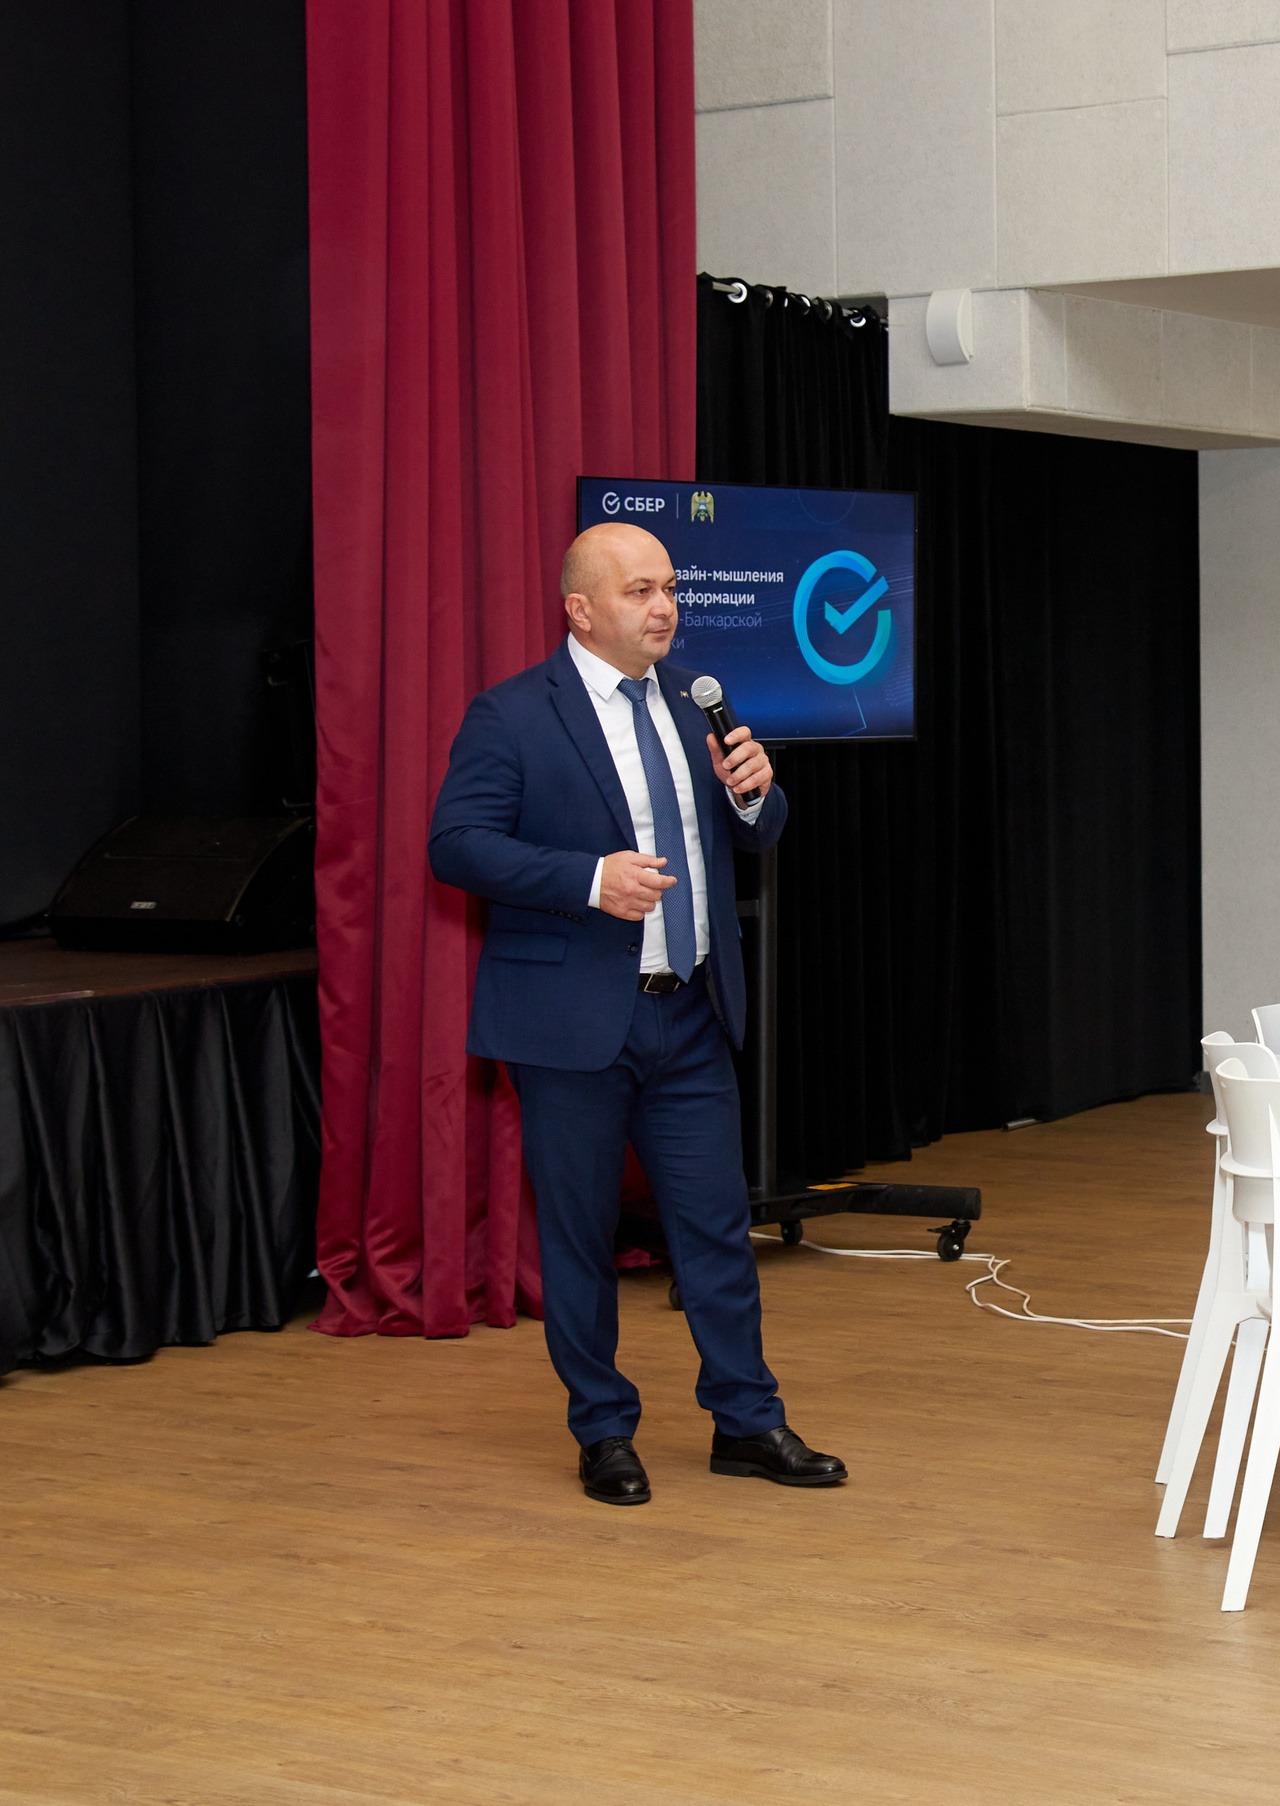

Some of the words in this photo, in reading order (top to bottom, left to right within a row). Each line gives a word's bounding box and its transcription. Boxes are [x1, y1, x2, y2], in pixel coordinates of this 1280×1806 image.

[623, 496, 666, 513] СБЕР
[675, 564, 785, 583] зайн-мышления
[673, 587, 756, 608] нсформации
[679, 611, 763, 630] -Балкарской
